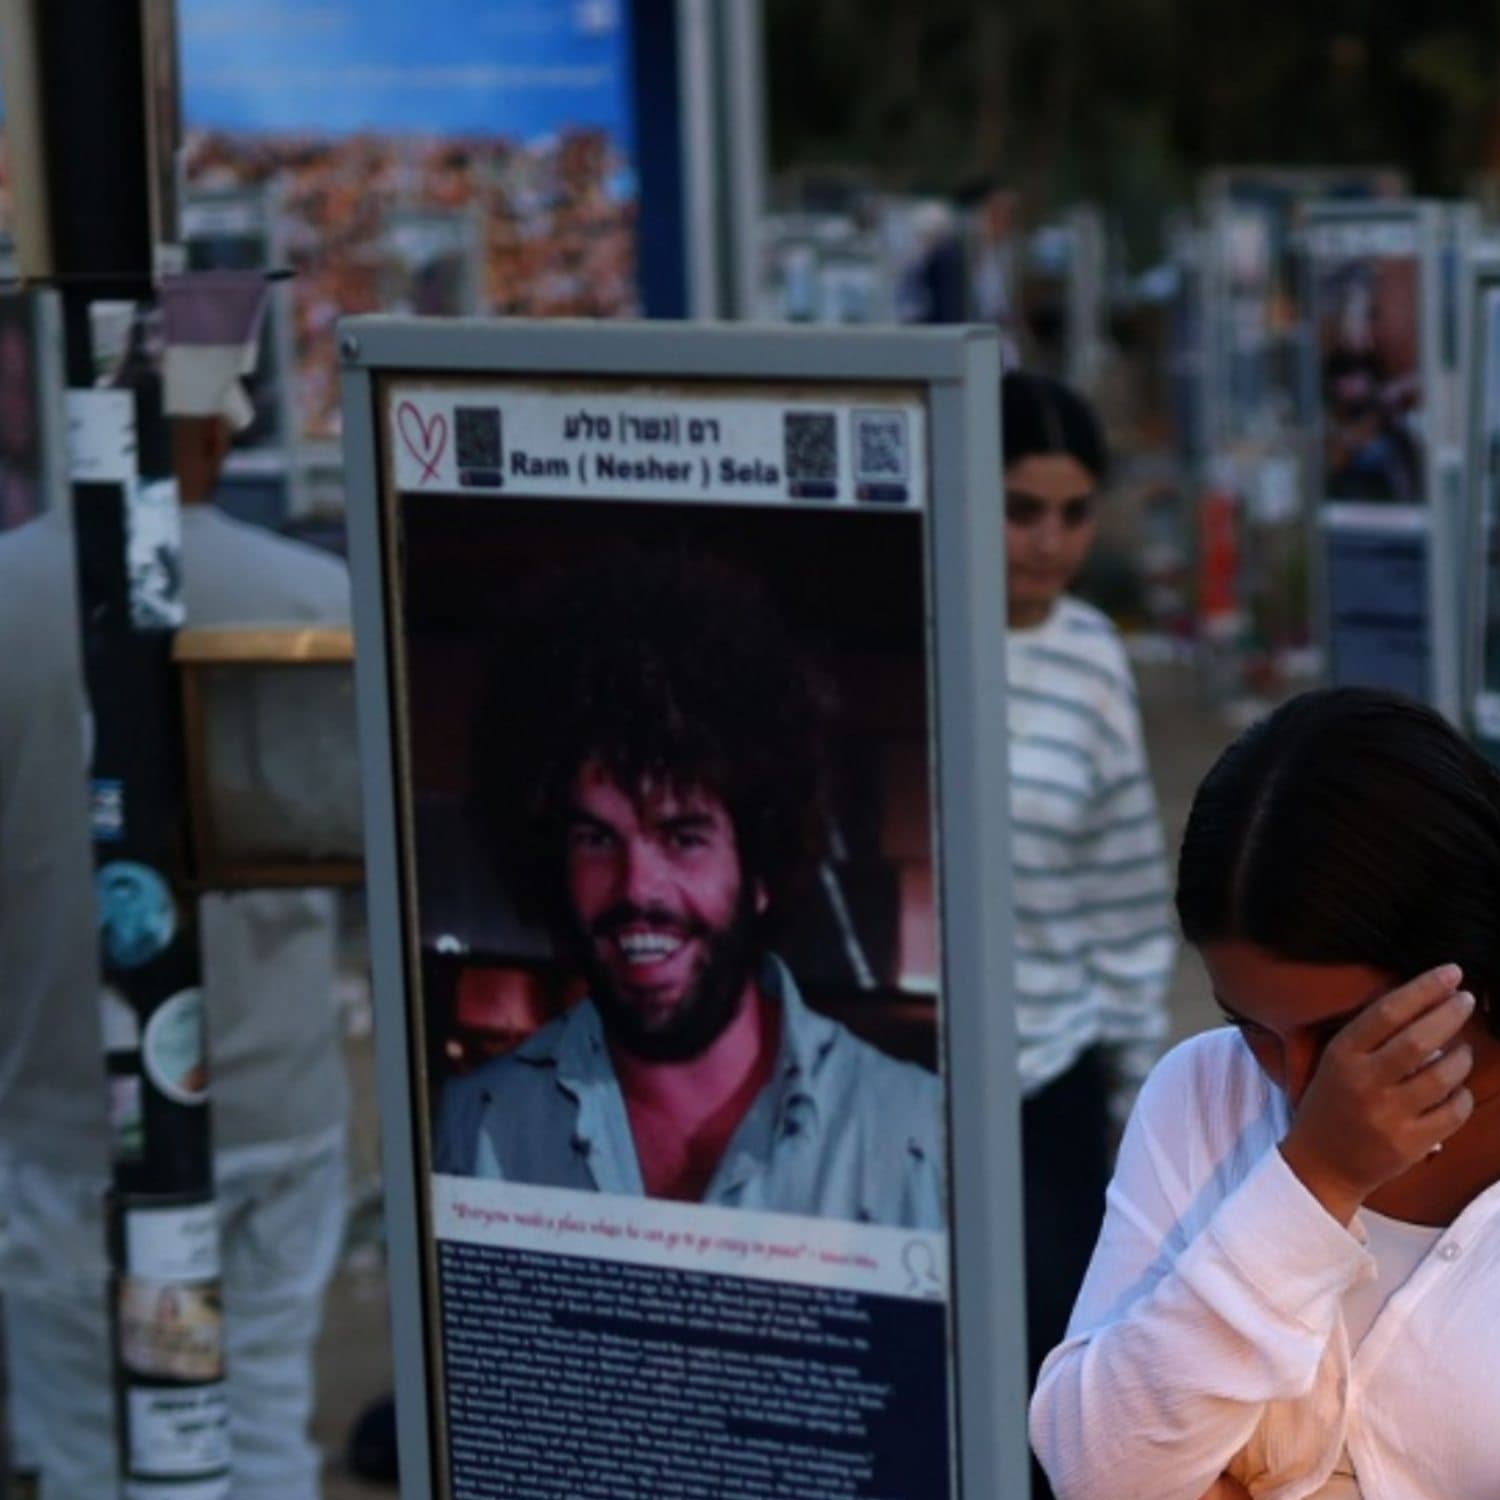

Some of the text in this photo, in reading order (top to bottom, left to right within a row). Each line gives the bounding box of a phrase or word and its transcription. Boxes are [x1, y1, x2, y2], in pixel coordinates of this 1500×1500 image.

[564, 410, 611, 440] סלע
[689, 419, 720, 444] רם
[510, 451, 569, 476] Ram
[596, 453, 691, 482] Nesher
[719, 457, 779, 484] Sela
